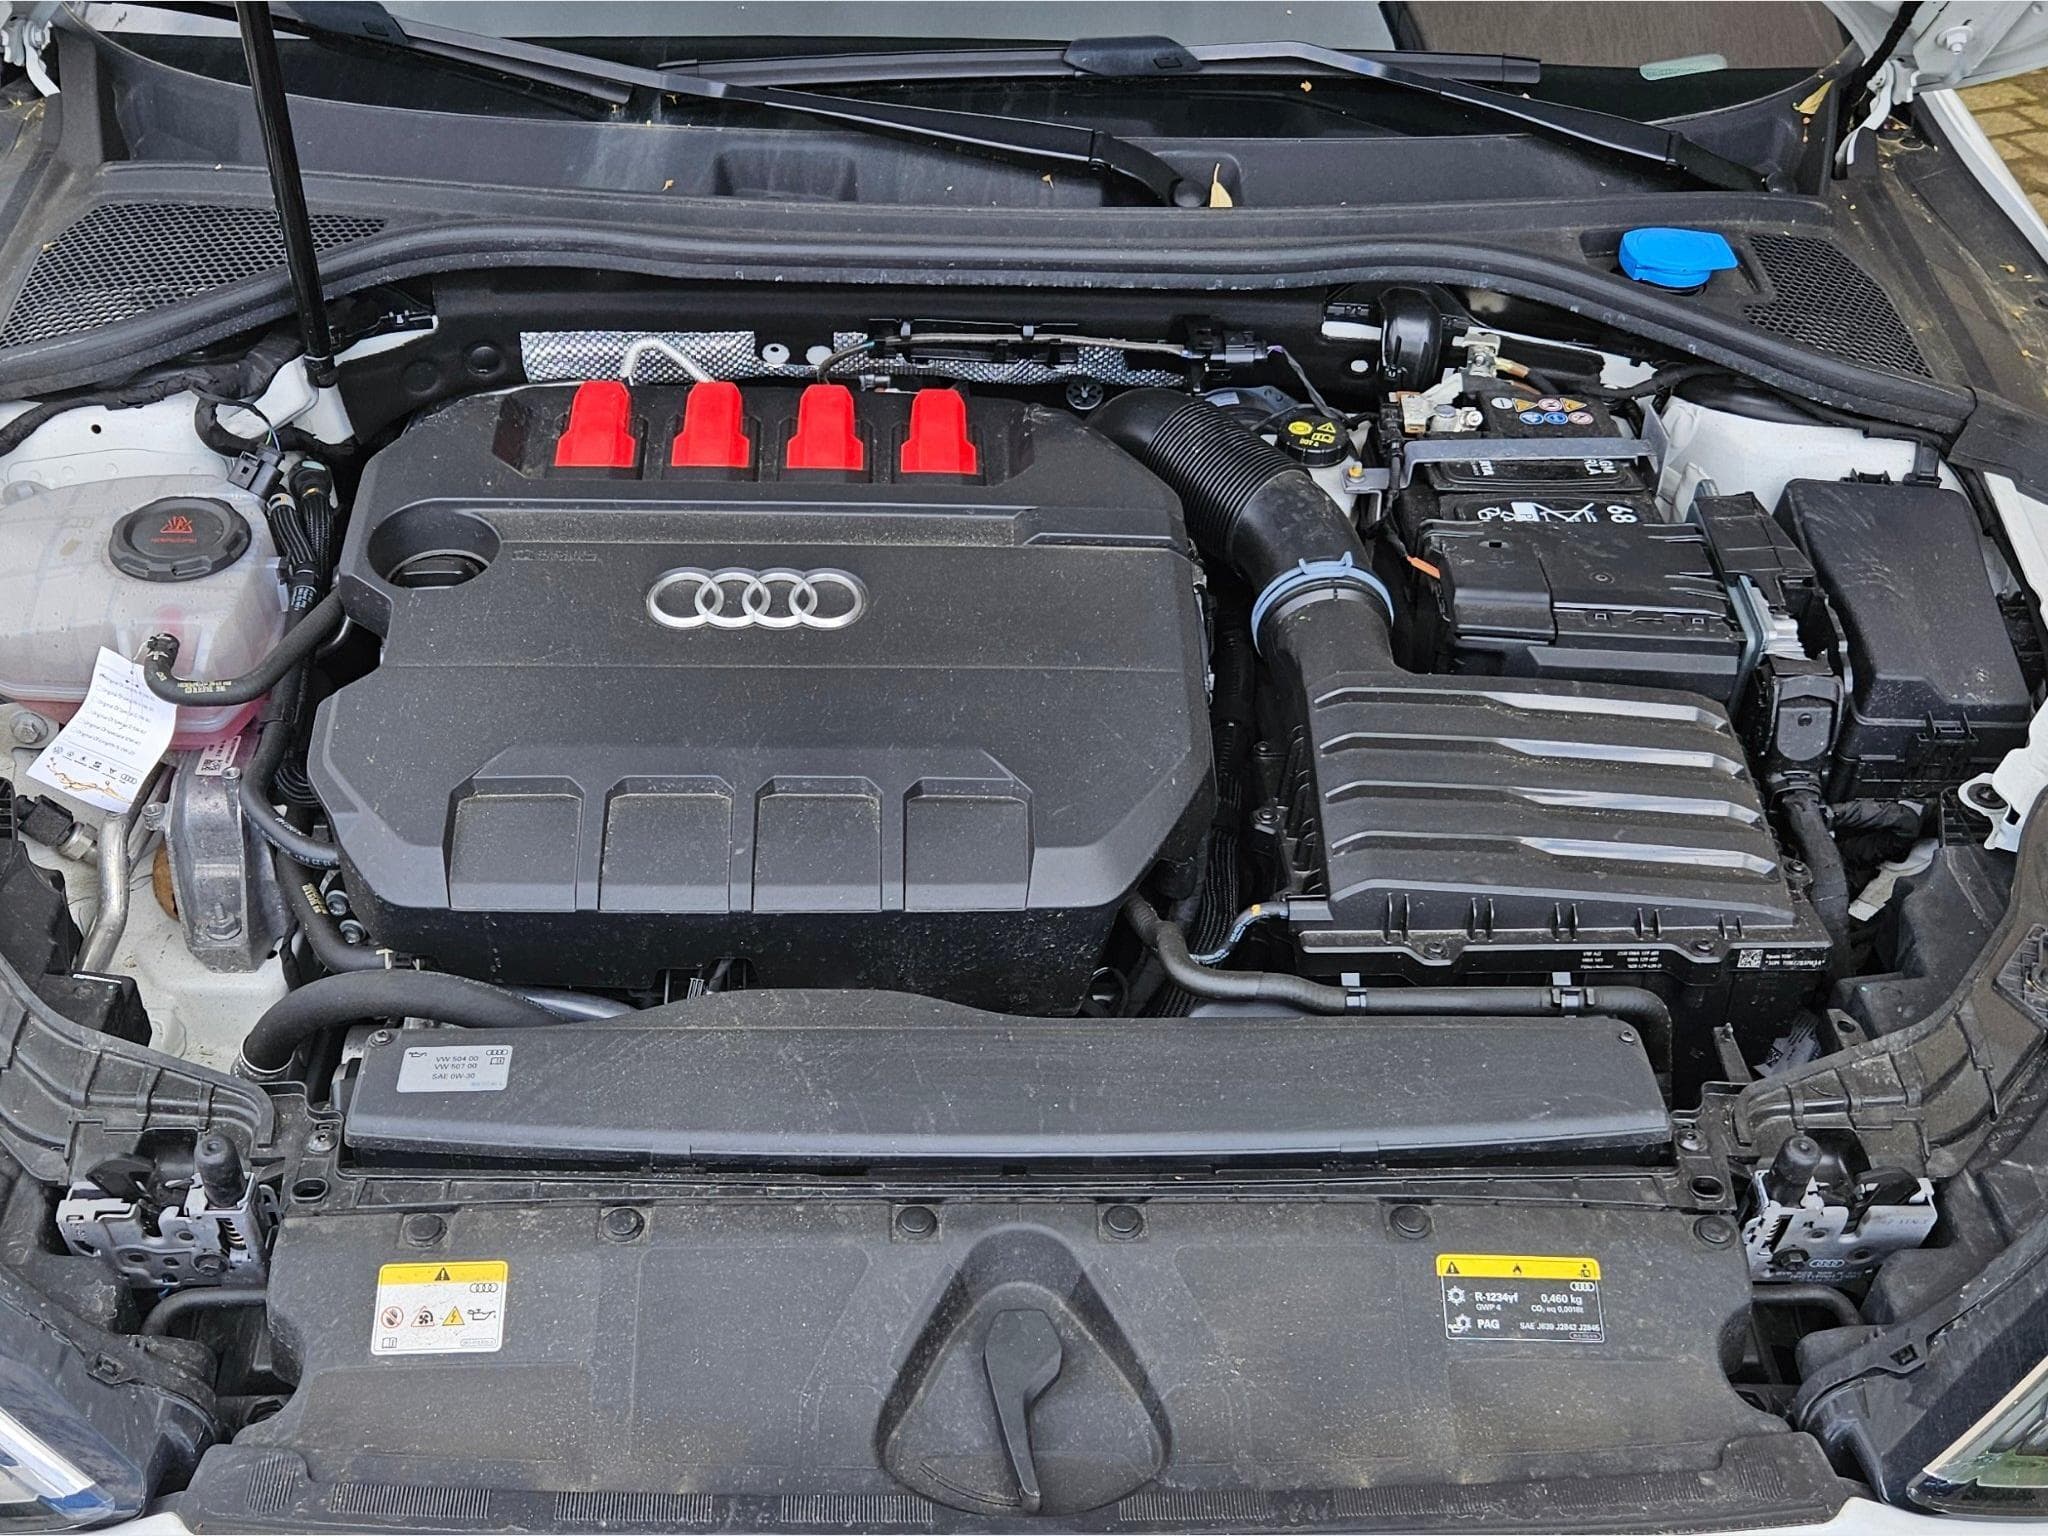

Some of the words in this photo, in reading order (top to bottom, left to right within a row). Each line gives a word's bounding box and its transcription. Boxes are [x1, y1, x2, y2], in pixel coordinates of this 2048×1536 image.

[1599, 460, 1617, 474] GM
[1606, 504, 1638, 524] 68
[467, 1062, 478, 1070] 00
[1474, 1291, 1519, 1304] R-1234yf
[1570, 1294, 1583, 1306] kg
[1475, 1303, 1496, 1311] GWP
[1495, 1303, 1502, 1311] 4
[1476, 1318, 1501, 1330] PAG
[1519, 1321, 1535, 1330] SAE
